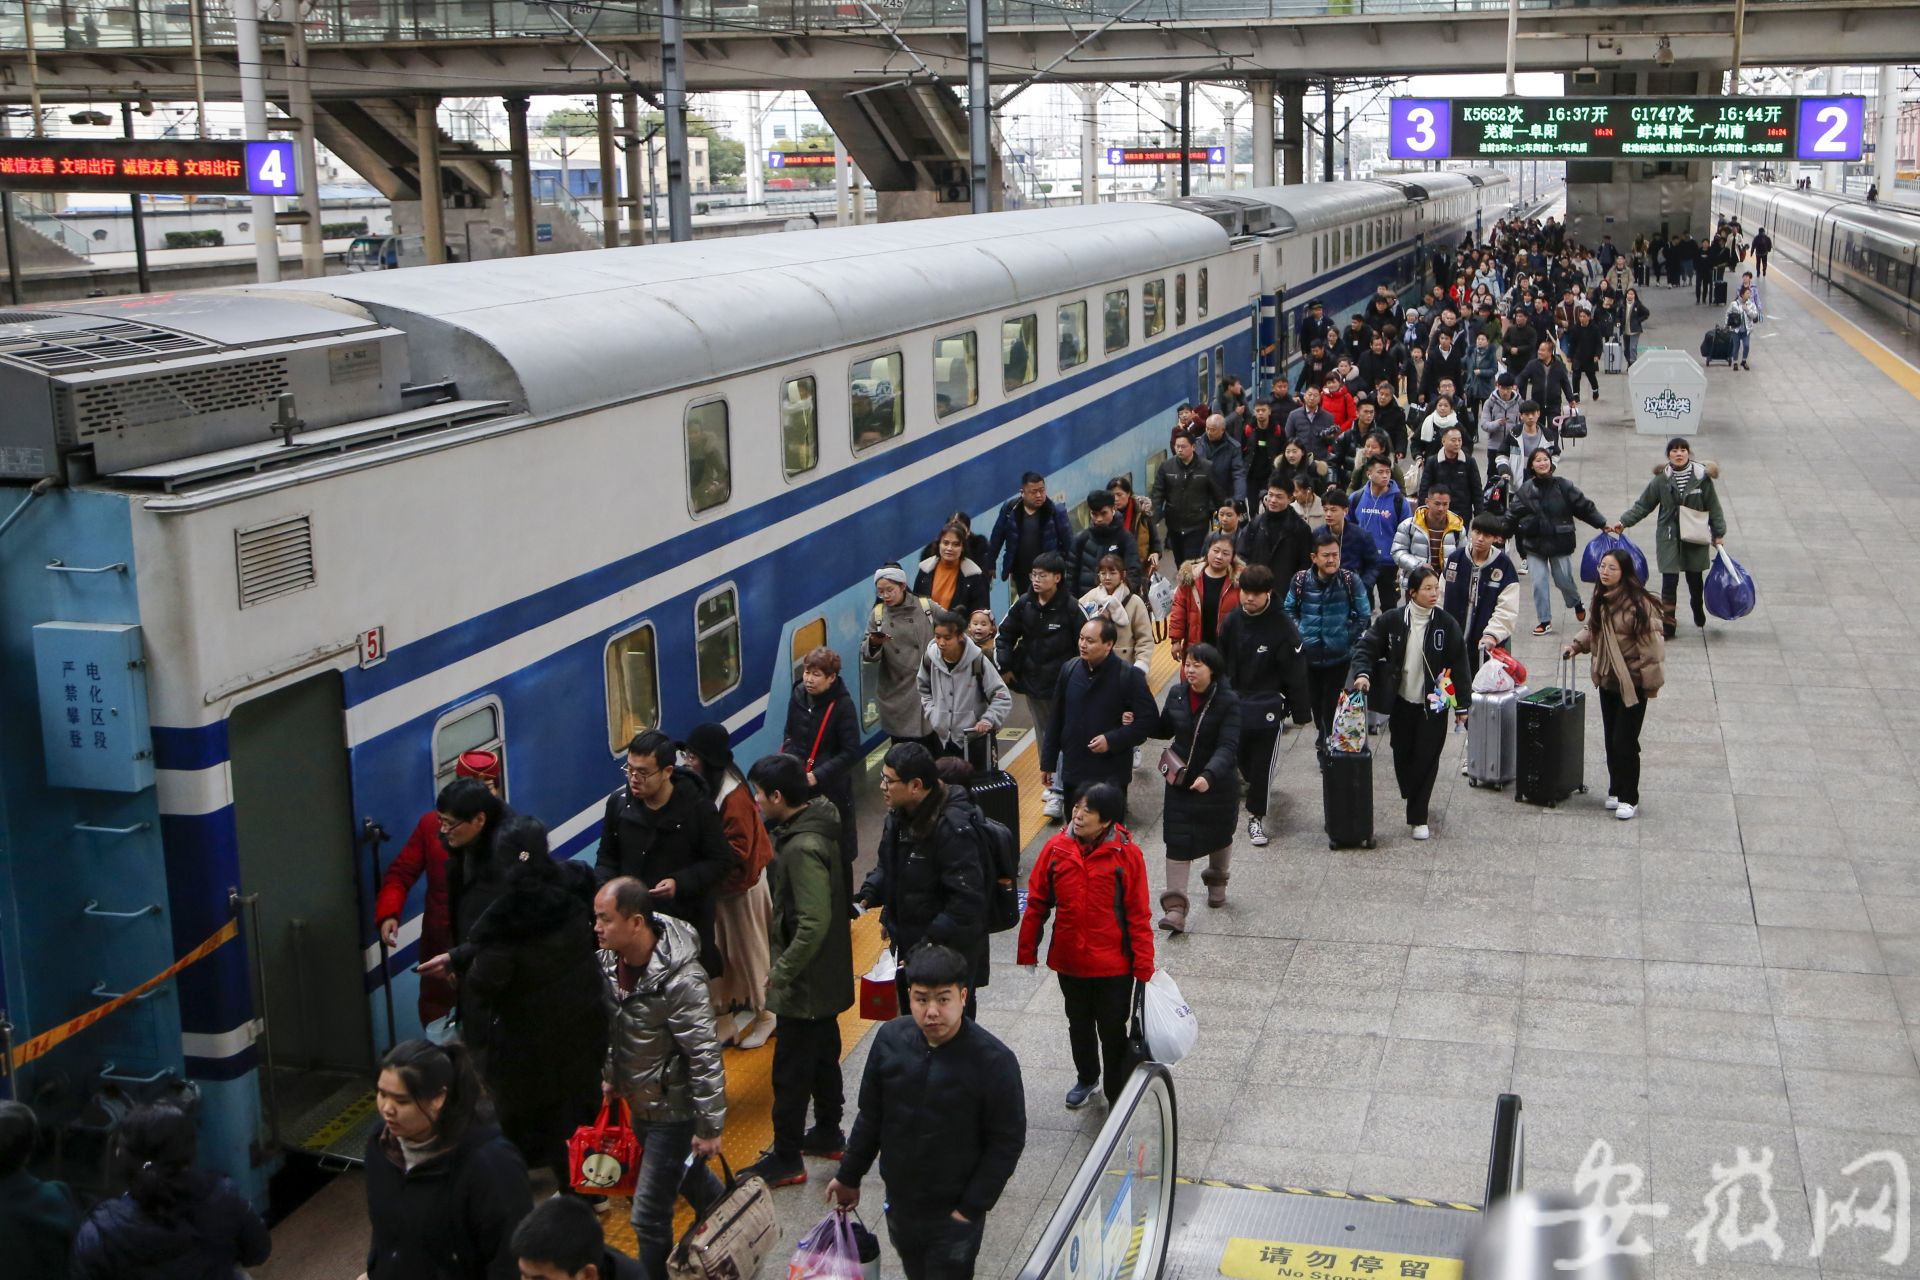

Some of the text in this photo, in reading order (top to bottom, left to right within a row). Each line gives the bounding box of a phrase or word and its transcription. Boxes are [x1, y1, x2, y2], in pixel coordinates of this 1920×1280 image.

[1463, 106, 1609, 123] K5662次 16:37开
[1631, 105, 1782, 123] G1747次 16:44开
[1405, 107, 1437, 152] 3
[1813, 106, 1849, 152] 2
[771, 154, 781, 167] 7
[1111, 150, 1121, 164] 5
[1211, 149, 1222, 162] 4
[0, 157, 241, 176] 诚信友善 文明出行 诚信友善 文明出行
[259, 149, 287, 188] 4
[1644, 397, 1690, 413] 垃圾分类
[367, 630, 377, 659] 5
[62, 661, 83, 749] 严禁攀登
[86, 662, 108, 750] 电化区段
[1259, 1246, 1430, 1279] 请勿停留
[1277, 1268, 1304, 1278] No
